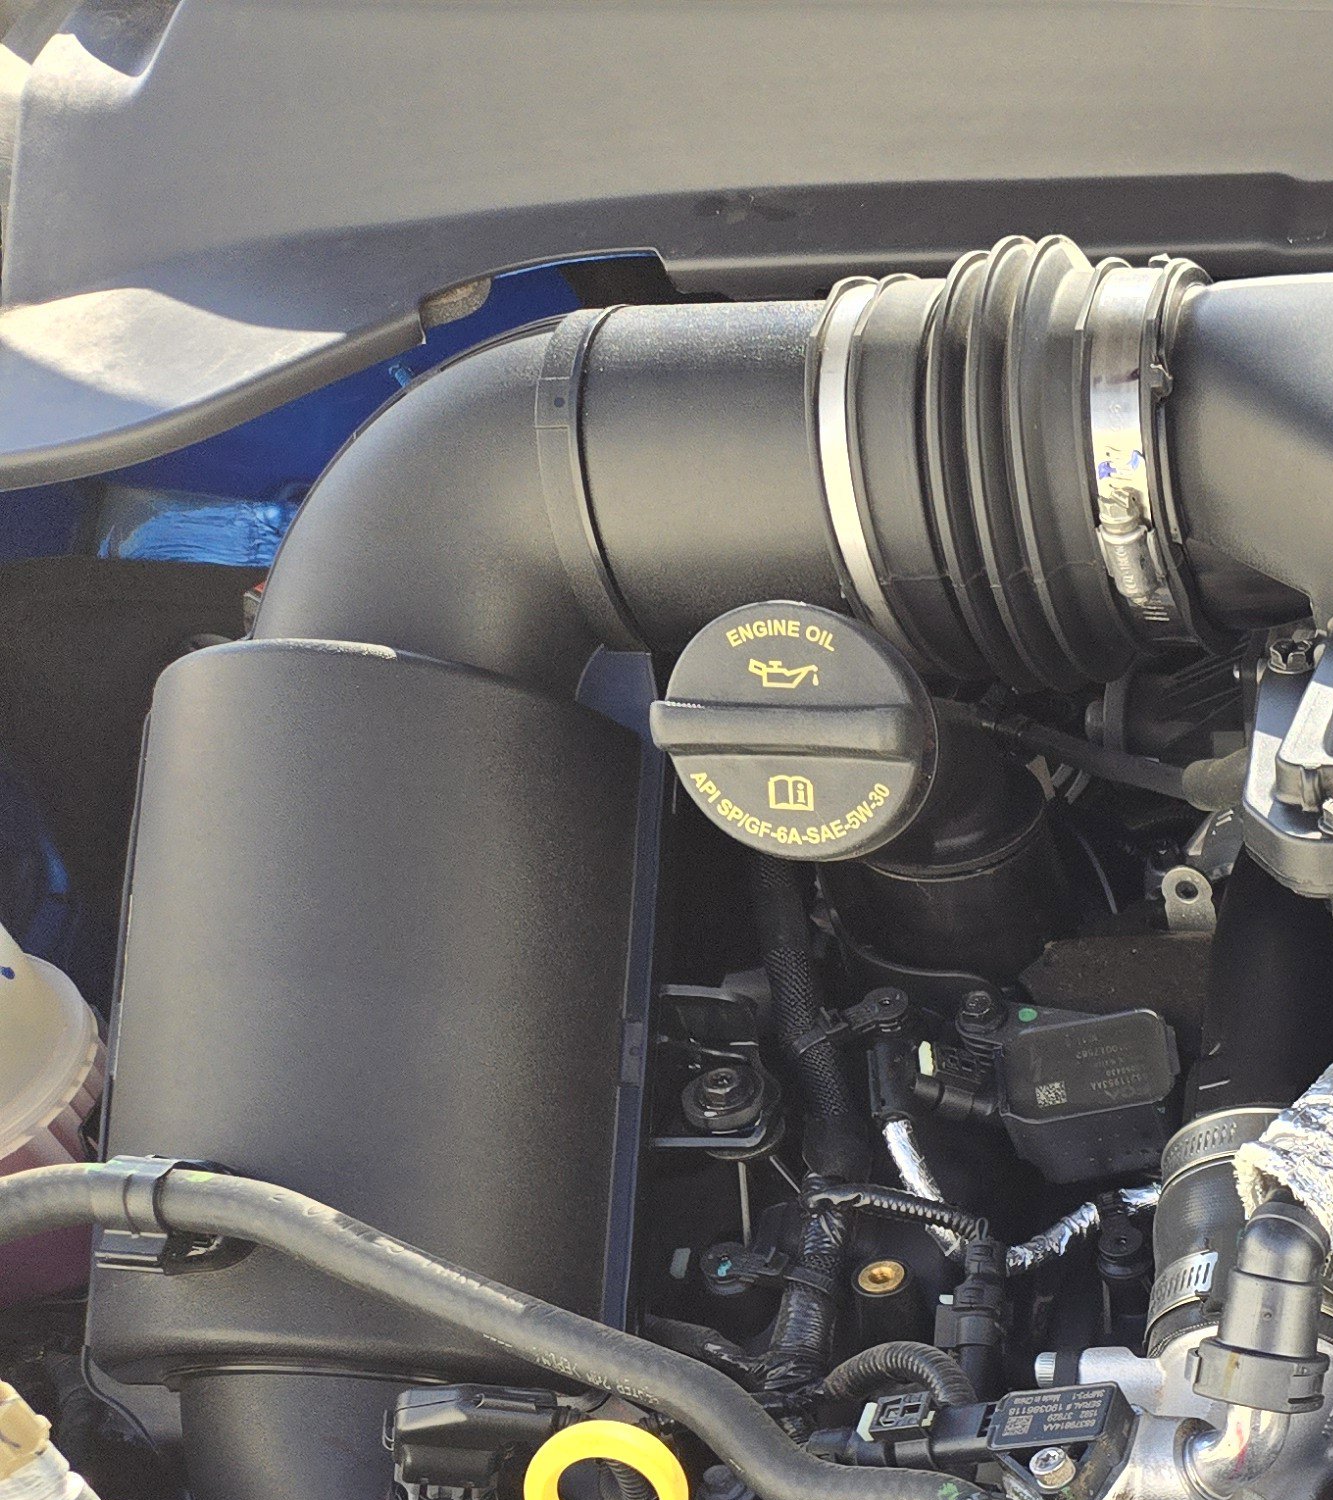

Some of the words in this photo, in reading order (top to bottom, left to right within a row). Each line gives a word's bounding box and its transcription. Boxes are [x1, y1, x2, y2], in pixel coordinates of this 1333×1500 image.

[726, 619, 800, 648] ENGINE
[805, 625, 836, 652] OIL
[690, 771, 722, 803] API
[717, 783, 890, 845] SP/GF-6A-SAE-5W-30
[1074, 1400, 1103, 1410] SERIAL
